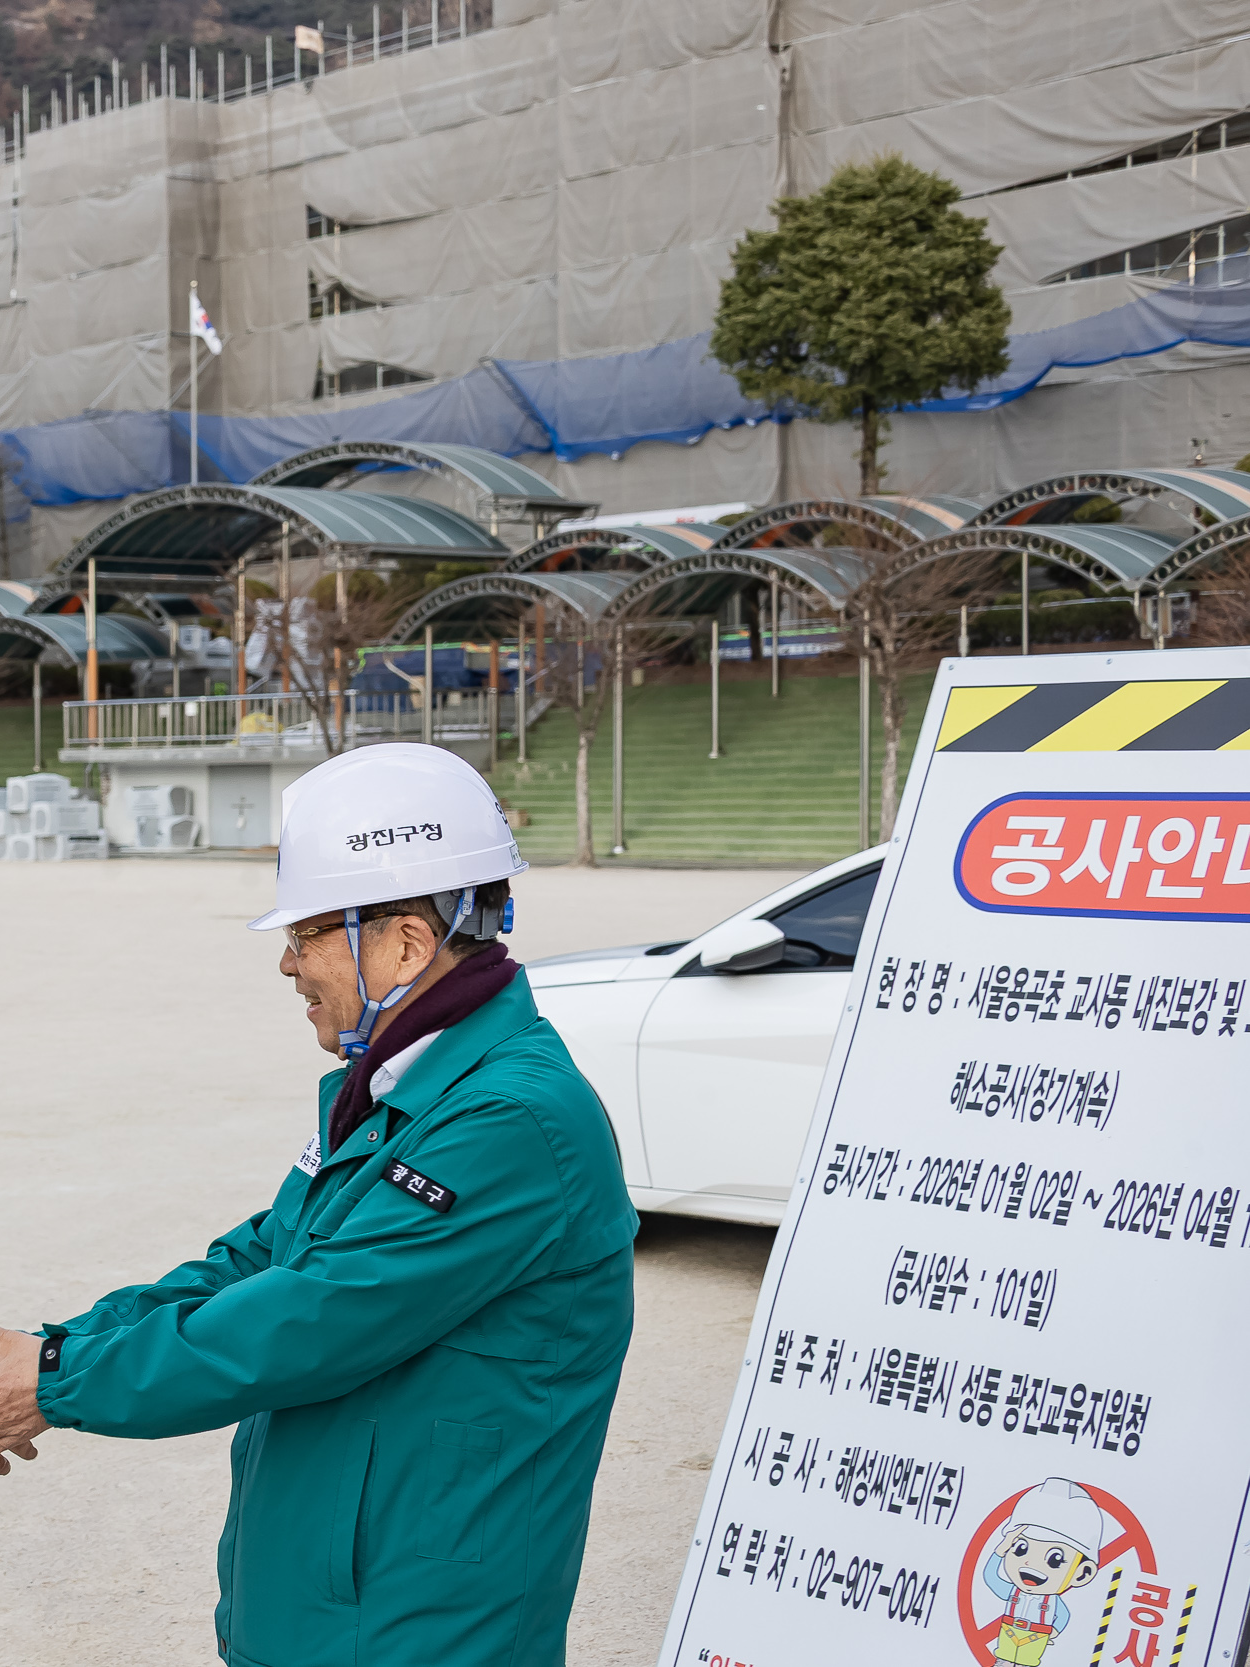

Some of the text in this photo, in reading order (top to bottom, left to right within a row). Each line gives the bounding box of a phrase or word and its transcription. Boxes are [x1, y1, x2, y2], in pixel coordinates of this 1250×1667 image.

[346, 823, 443, 852] 광진구청
[967, 965, 1066, 1023] 서울용곡초
[1065, 973, 1132, 1030] 교사동
[1132, 976, 1218, 1036] 내진보강
[1217, 979, 1247, 1037] 및
[949, 1060, 1120, 1132] 해소공사(장기계속)
[392, 1164, 444, 1204] 광진구
[823, 1143, 901, 1200] 공사기간
[912, 1157, 984, 1213] 2026년
[981, 1162, 1032, 1220] 01월
[1030, 1169, 1082, 1227] 02일
[1103, 1178, 1185, 1241] 2026년
[1183, 1187, 1241, 1249] 04월
[990, 1267, 1058, 1332] 101일)
[859, 1347, 959, 1419] 서울특별시
[958, 1365, 1003, 1427] 성동
[1002, 1374, 1152, 1457] 광진교육지원청
[835, 1446, 965, 1530] 해성씨앤디(주)
[806, 1547, 941, 1629] 02-907-0041
